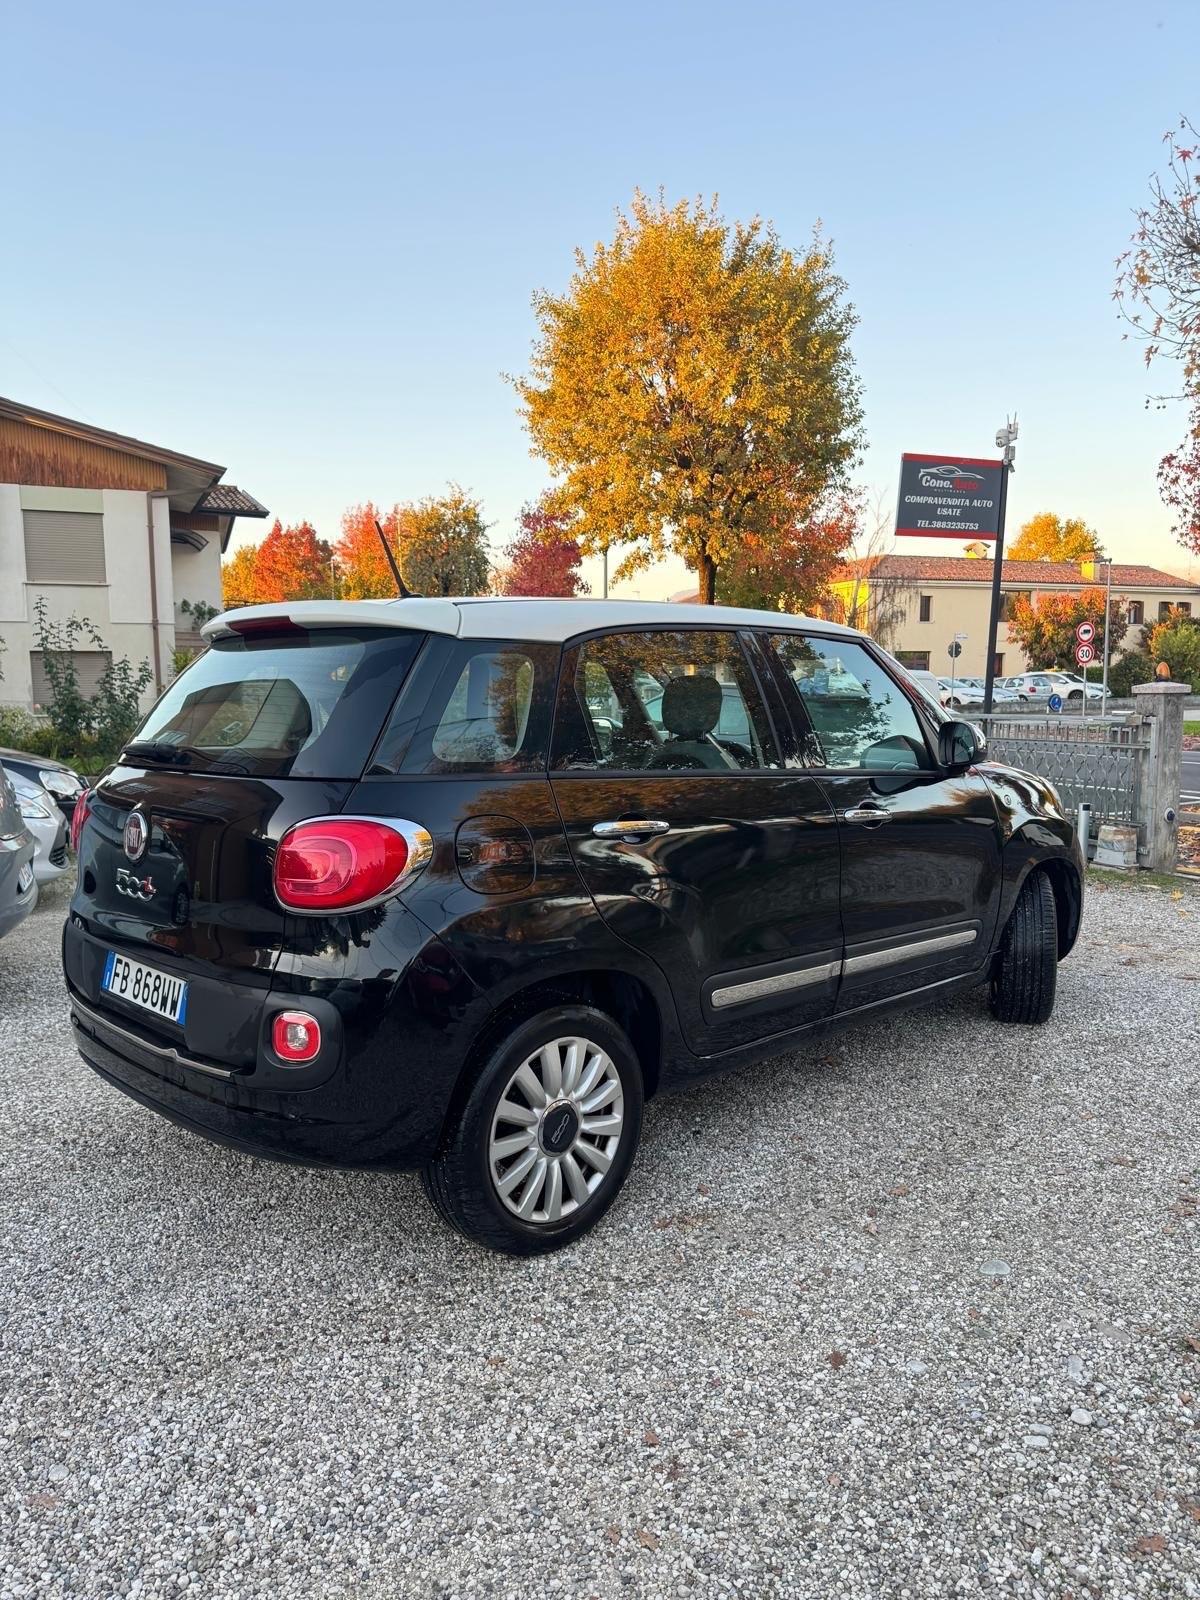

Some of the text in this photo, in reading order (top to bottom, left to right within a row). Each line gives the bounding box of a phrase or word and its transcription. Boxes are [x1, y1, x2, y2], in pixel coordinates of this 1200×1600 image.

[904, 495, 993, 508] COMPRAVENDITA AUTO
[937, 507, 962, 516] USATE
[1080, 649, 1090, 659] 30
[111, 957, 131, 994] FB
